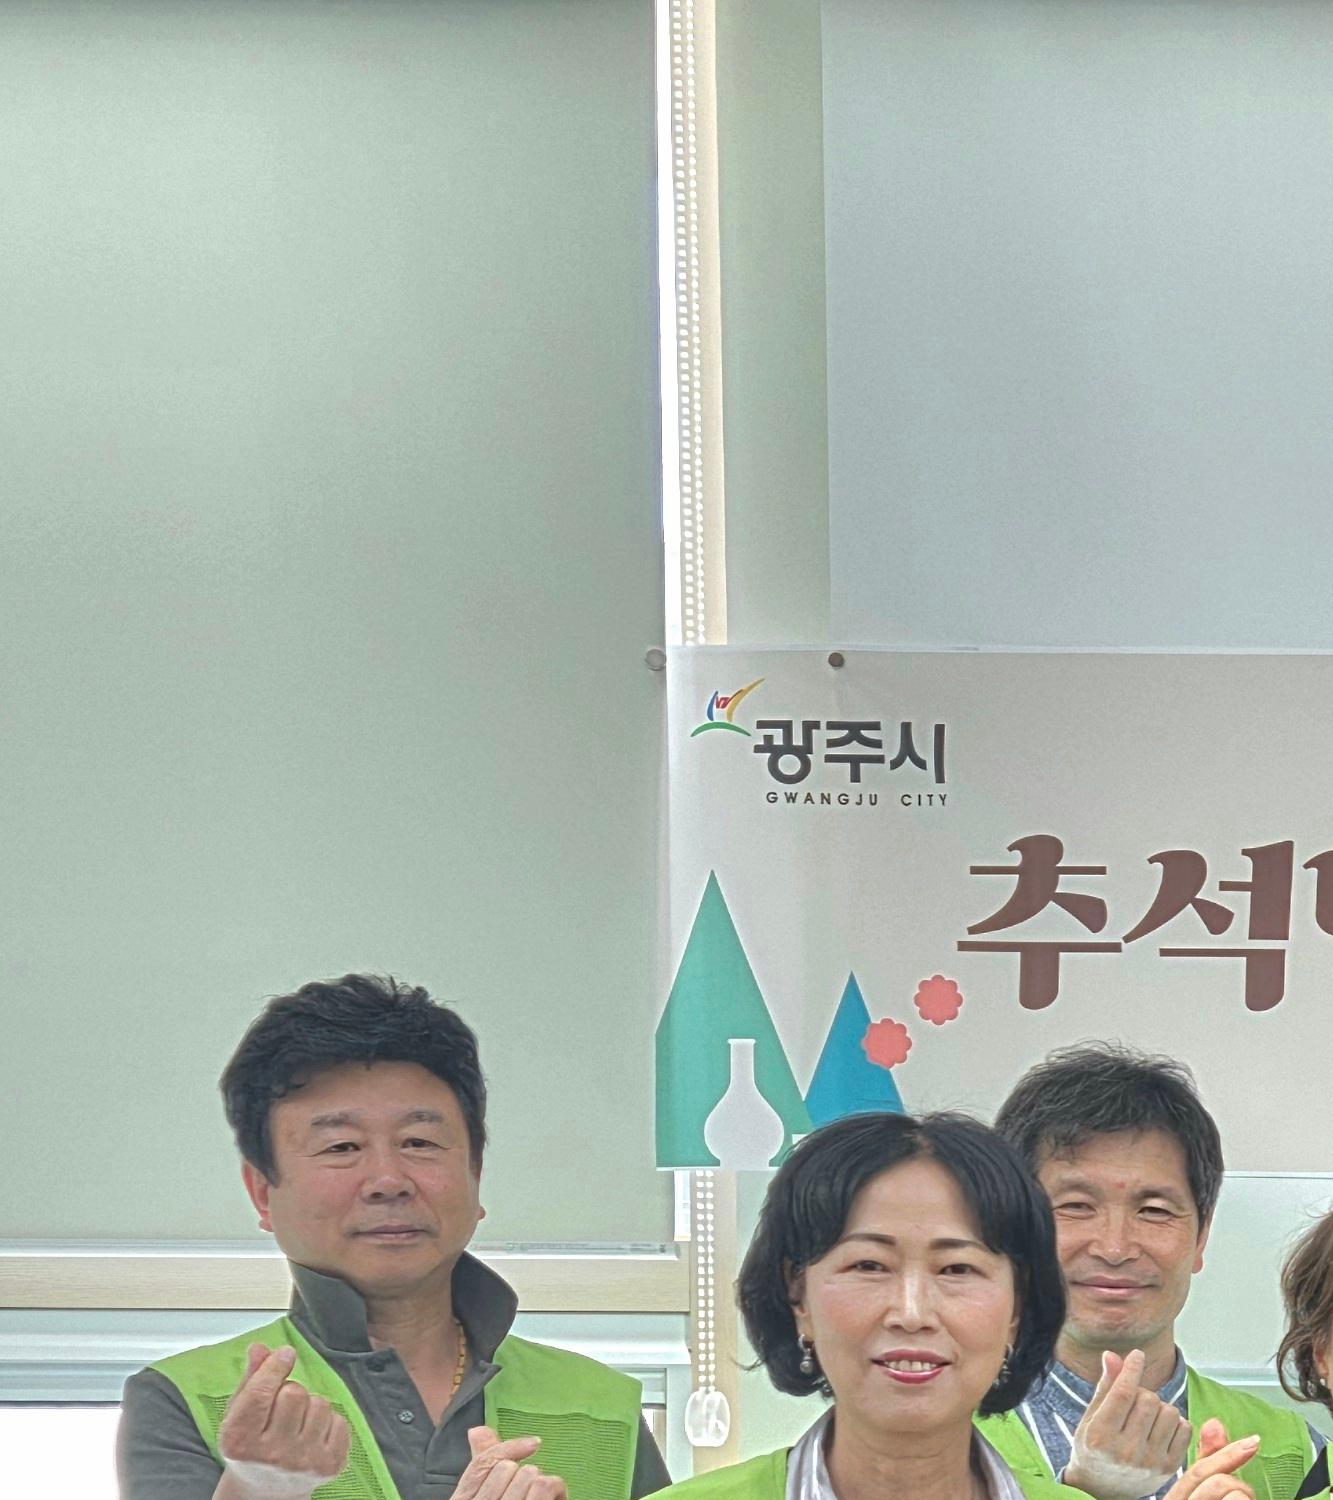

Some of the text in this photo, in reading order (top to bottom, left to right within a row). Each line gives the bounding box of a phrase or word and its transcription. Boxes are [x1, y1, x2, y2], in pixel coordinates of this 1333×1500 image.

[754, 719, 946, 784] 광주시
[766, 791, 947, 806] GWANGJU CITY
